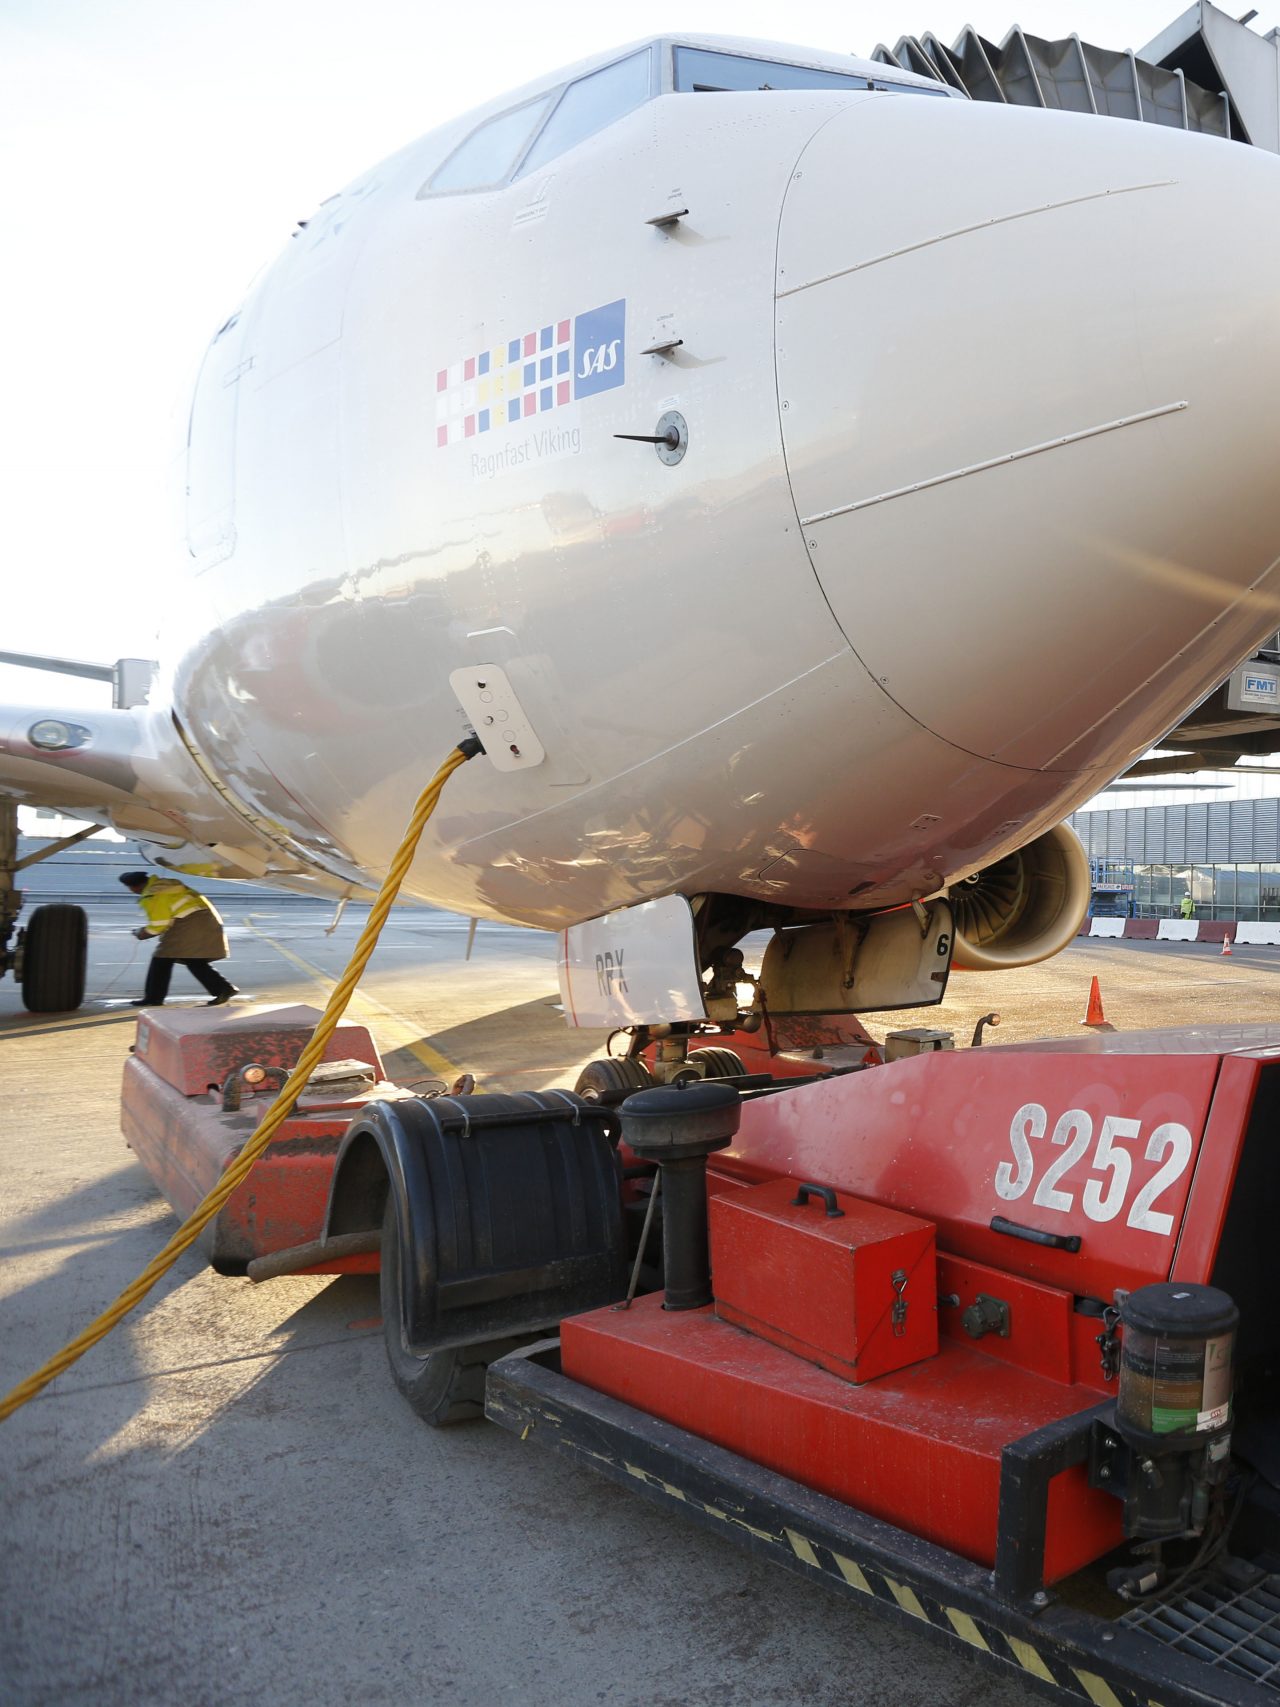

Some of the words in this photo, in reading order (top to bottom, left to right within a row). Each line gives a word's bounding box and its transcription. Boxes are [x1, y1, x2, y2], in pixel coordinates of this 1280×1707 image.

[577, 340, 621, 379] SAS
[471, 441, 531, 479] Ragnfast
[533, 426, 582, 455] Viking
[1247, 678, 1278, 693] FMT
[937, 934, 949, 957] 6
[995, 1103, 1193, 1236] S252
